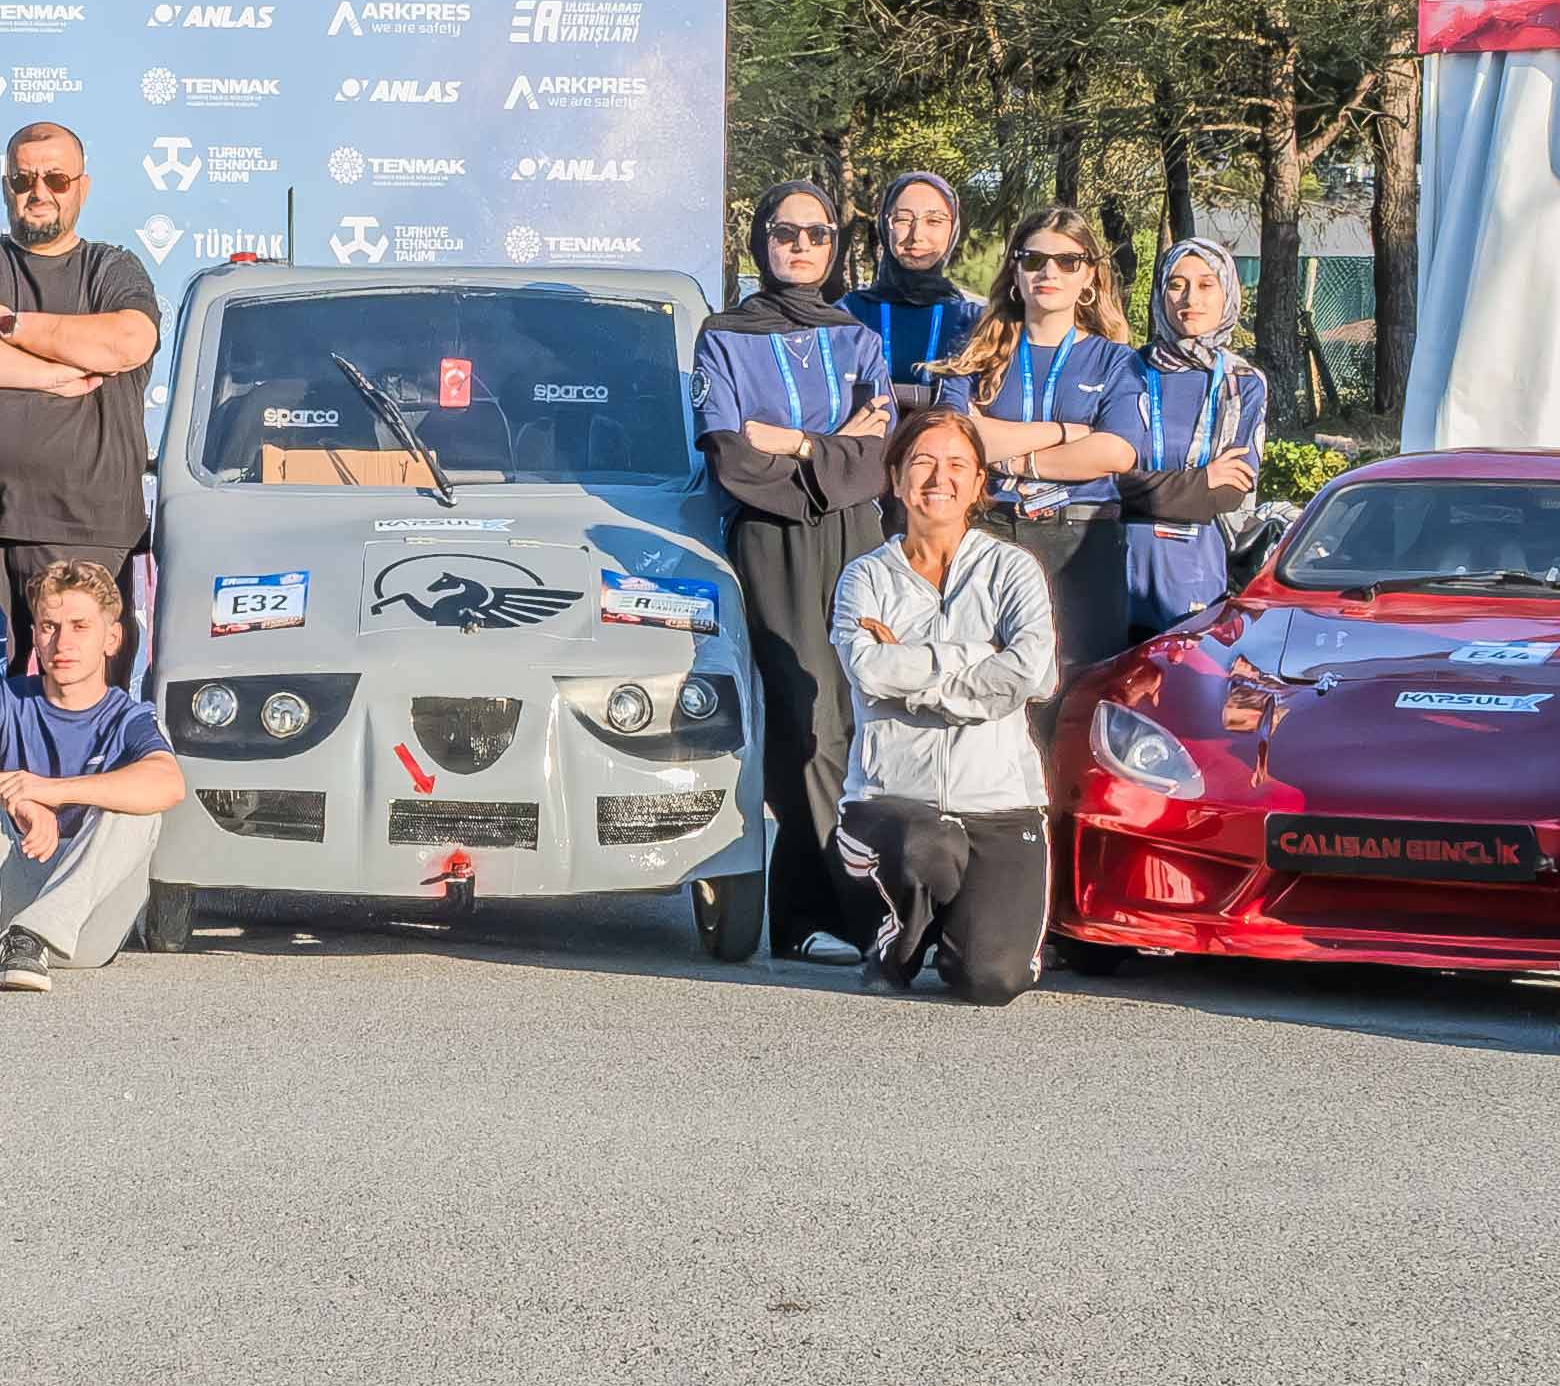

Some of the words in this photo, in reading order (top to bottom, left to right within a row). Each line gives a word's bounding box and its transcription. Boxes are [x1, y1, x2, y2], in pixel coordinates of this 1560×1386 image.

[183, 5, 276, 28] ANLAS
[362, 2, 471, 22] ARKPRES
[371, 23, 393, 35] we
[394, 23, 418, 35] are
[181, 78, 281, 95] TENMAK
[369, 80, 463, 103] ANLAS
[538, 76, 647, 95] ARKPRES
[368, 157, 466, 175] TENMAK
[545, 159, 638, 182] ANLAS
[193, 227, 284, 259] TÜBİTAK
[542, 235, 642, 253] TENMAK
[533, 383, 609, 402] sparco
[263, 407, 339, 427] sparco
[232, 594, 289, 615] E32
[1401, 693, 1510, 707] KAPSUL
